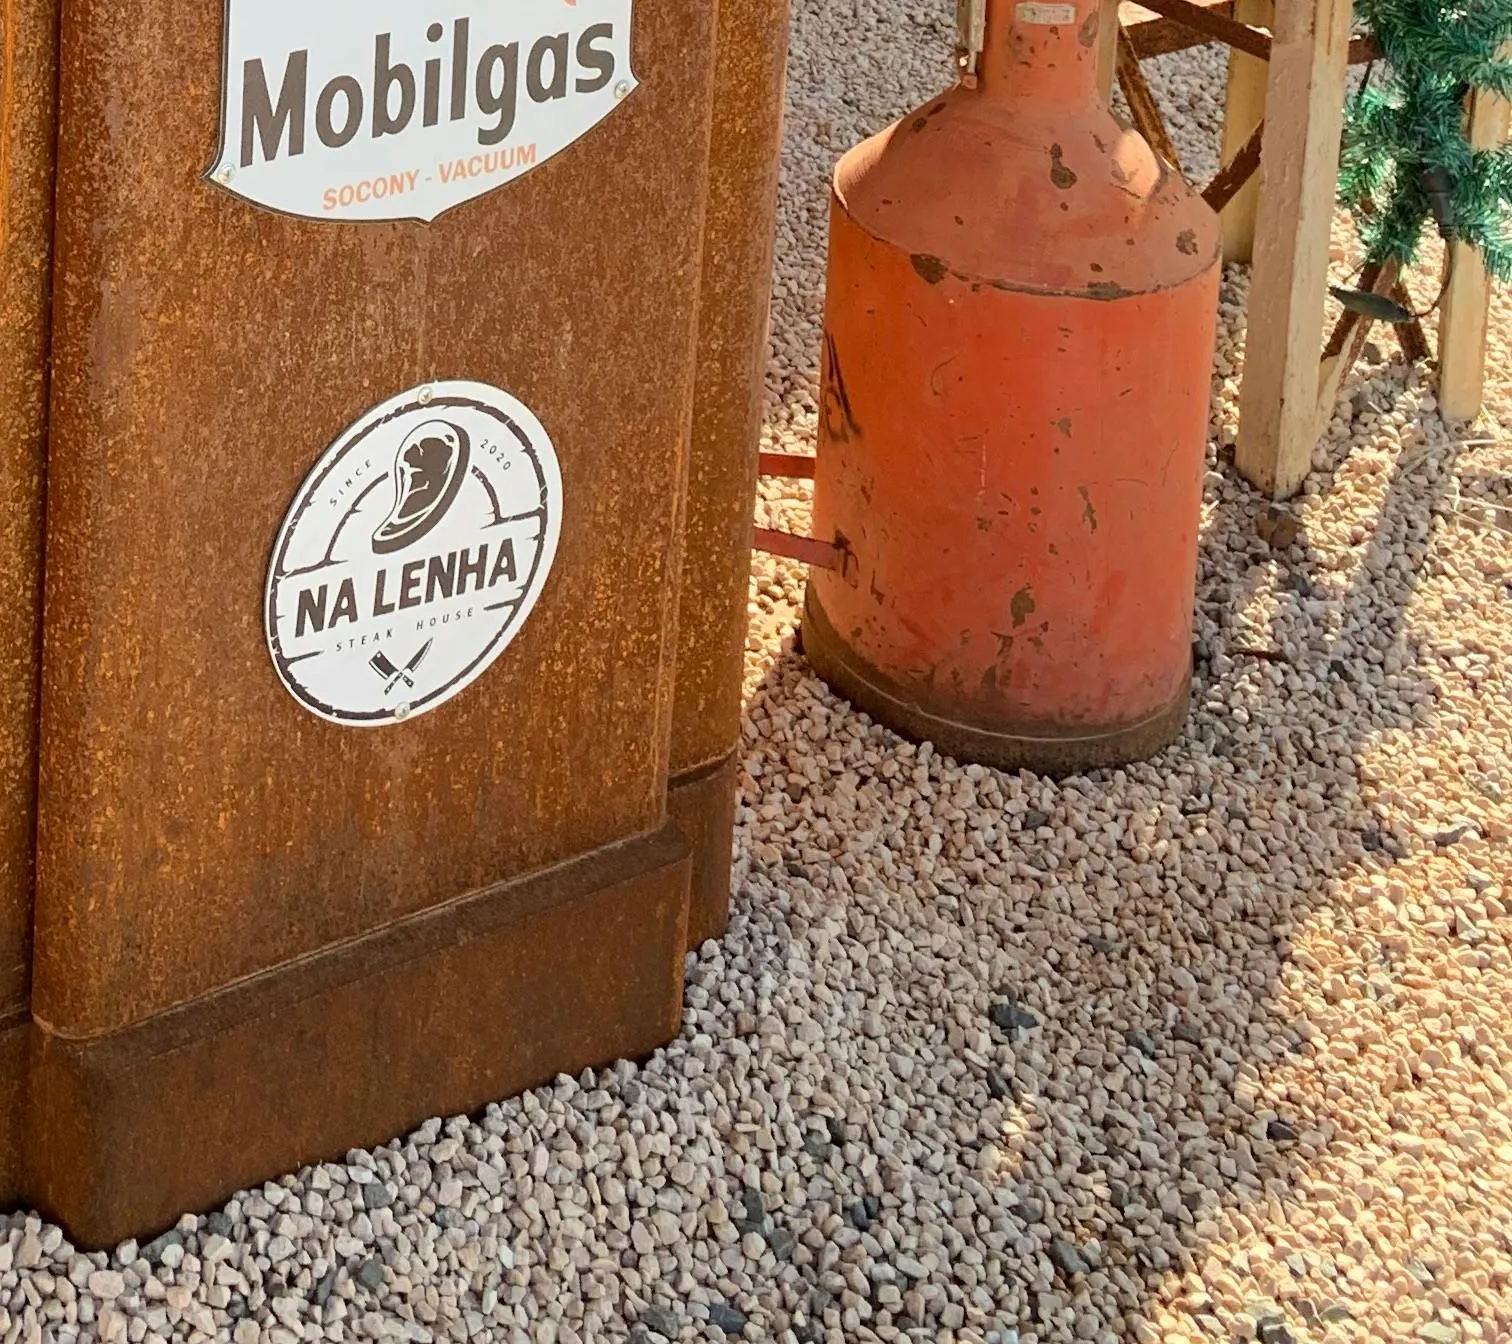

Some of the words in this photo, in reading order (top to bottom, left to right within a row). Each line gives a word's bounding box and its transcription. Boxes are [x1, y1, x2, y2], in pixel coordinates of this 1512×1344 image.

[240, 17, 616, 167] Mobilgas
[321, 168, 419, 211] SOCONY
[438, 142, 537, 186] VACUUM
[329, 458, 372, 507] SINCE
[479, 438, 512, 471] 2020
[294, 577, 359, 638] NA
[372, 537, 518, 617] LENHA
[335, 628, 395, 652] STEAK
[415, 607, 474, 632] HOUSE
